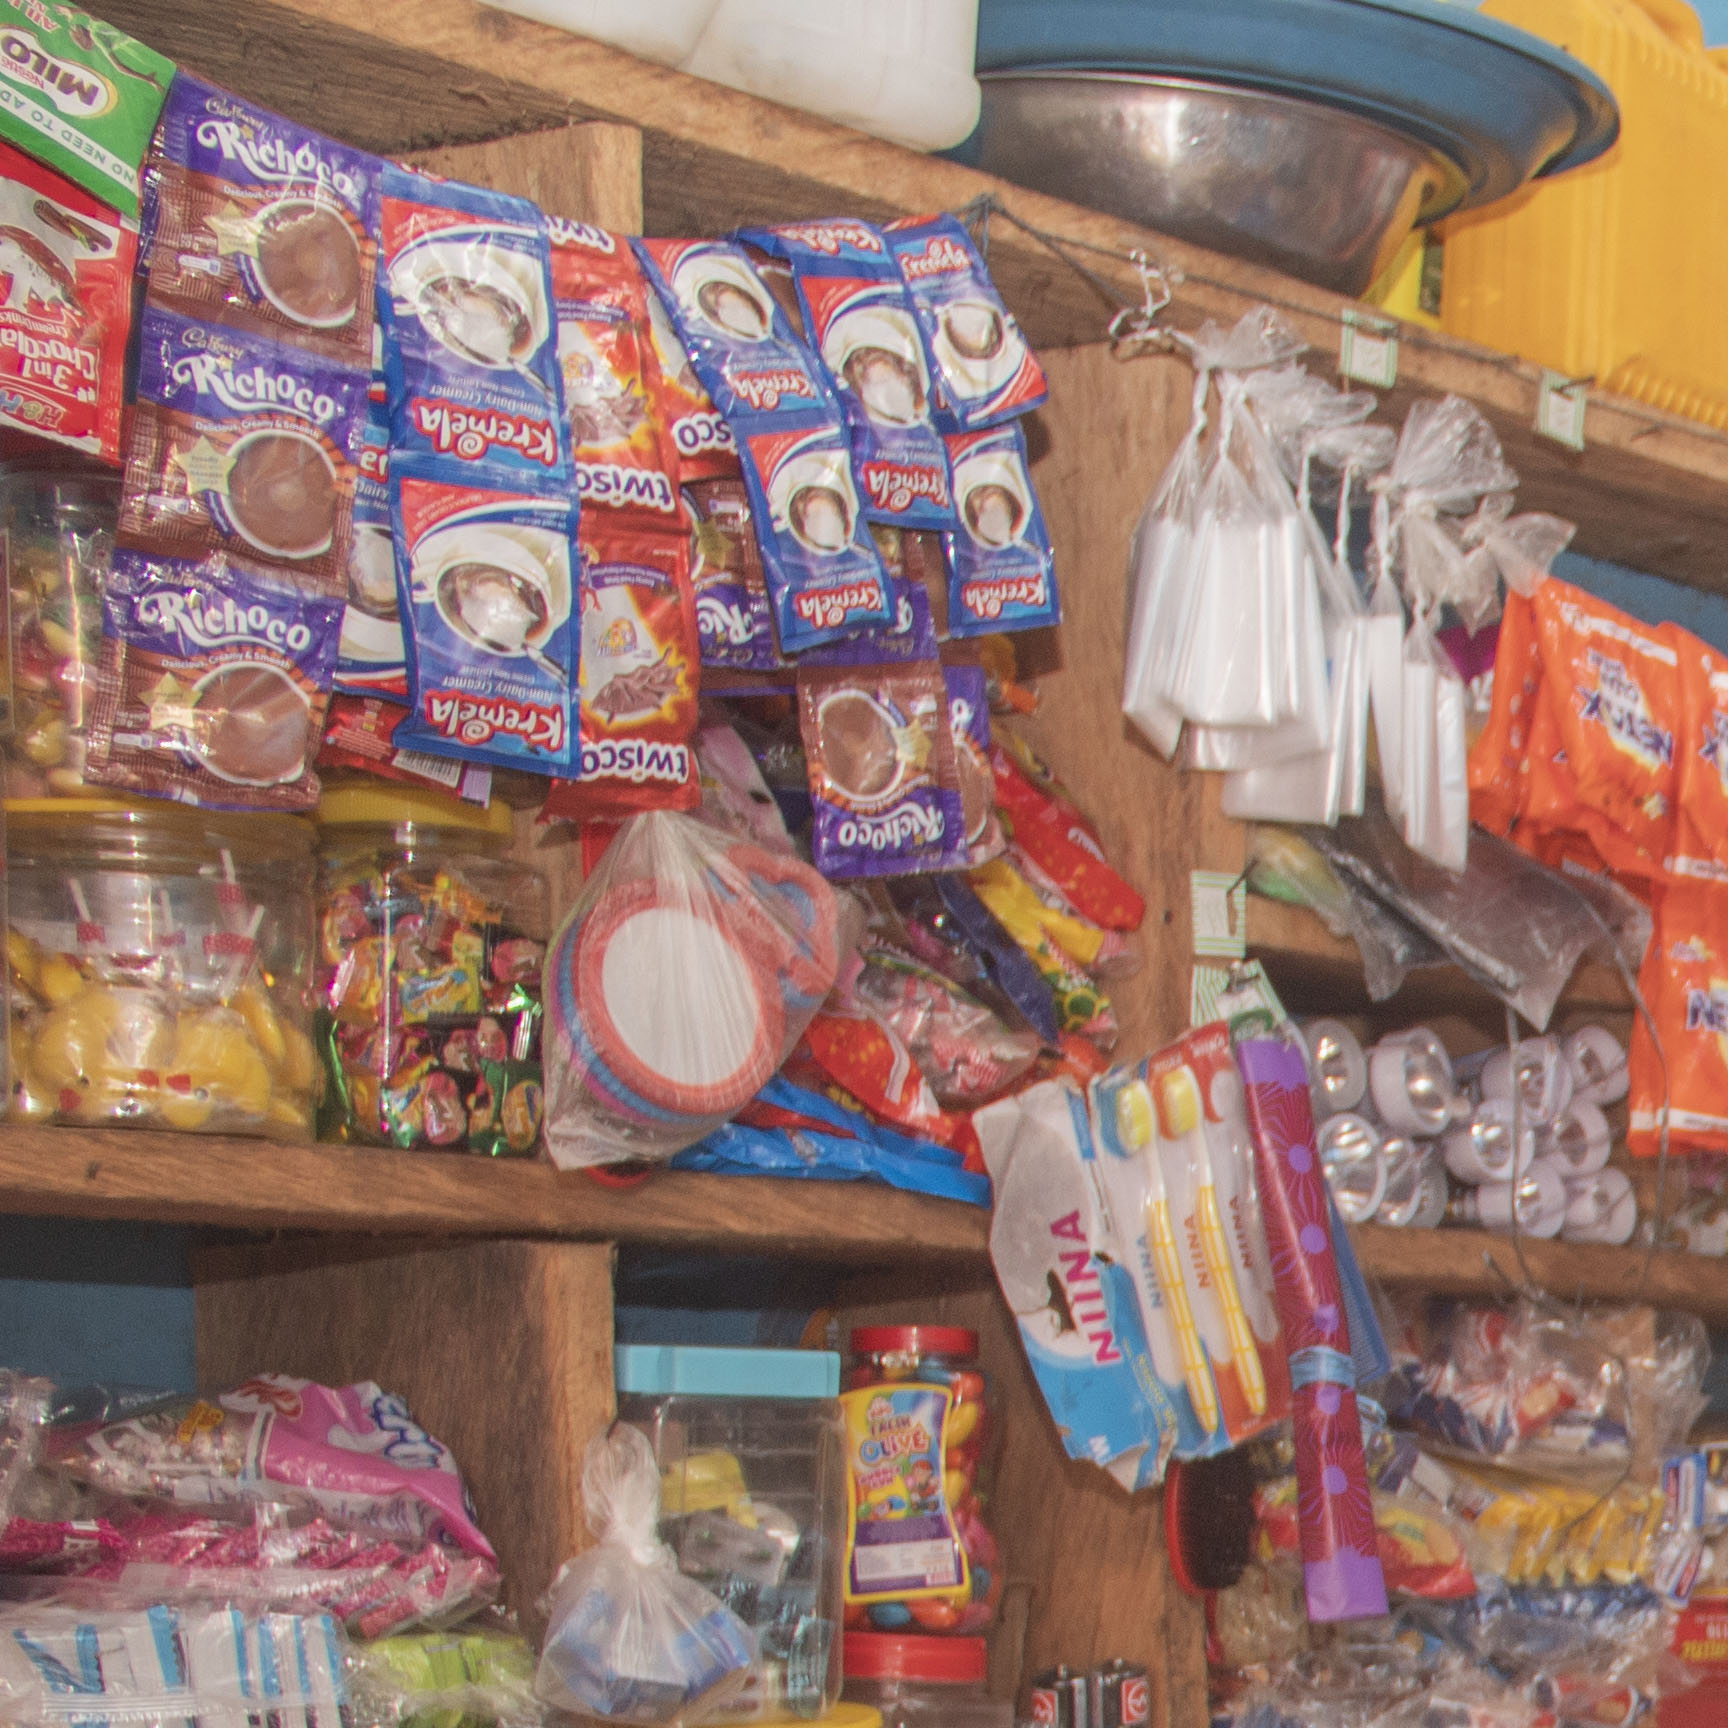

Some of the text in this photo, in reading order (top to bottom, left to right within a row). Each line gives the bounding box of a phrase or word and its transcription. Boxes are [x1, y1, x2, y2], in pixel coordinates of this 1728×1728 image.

[1, 34, 100, 107] MILO
[30, 109, 54, 131] TO
[60, 128, 106, 164] NEED
[197, 120, 362, 197] Richoco
[112, 165, 136, 185] NO
[172, 351, 336, 426] Richoco
[420, 404, 554, 463] Kremela
[799, 581, 885, 627] Kremela
[965, 576, 1047, 617] Kremela
[138, 589, 313, 656] Richoco
[441, 676, 492, 694] Creamer
[432, 696, 564, 748] Kremela
[581, 745, 687, 777] twisco
[838, 801, 946, 850] Richoco
[1050, 1209, 1123, 1364] NIINA
